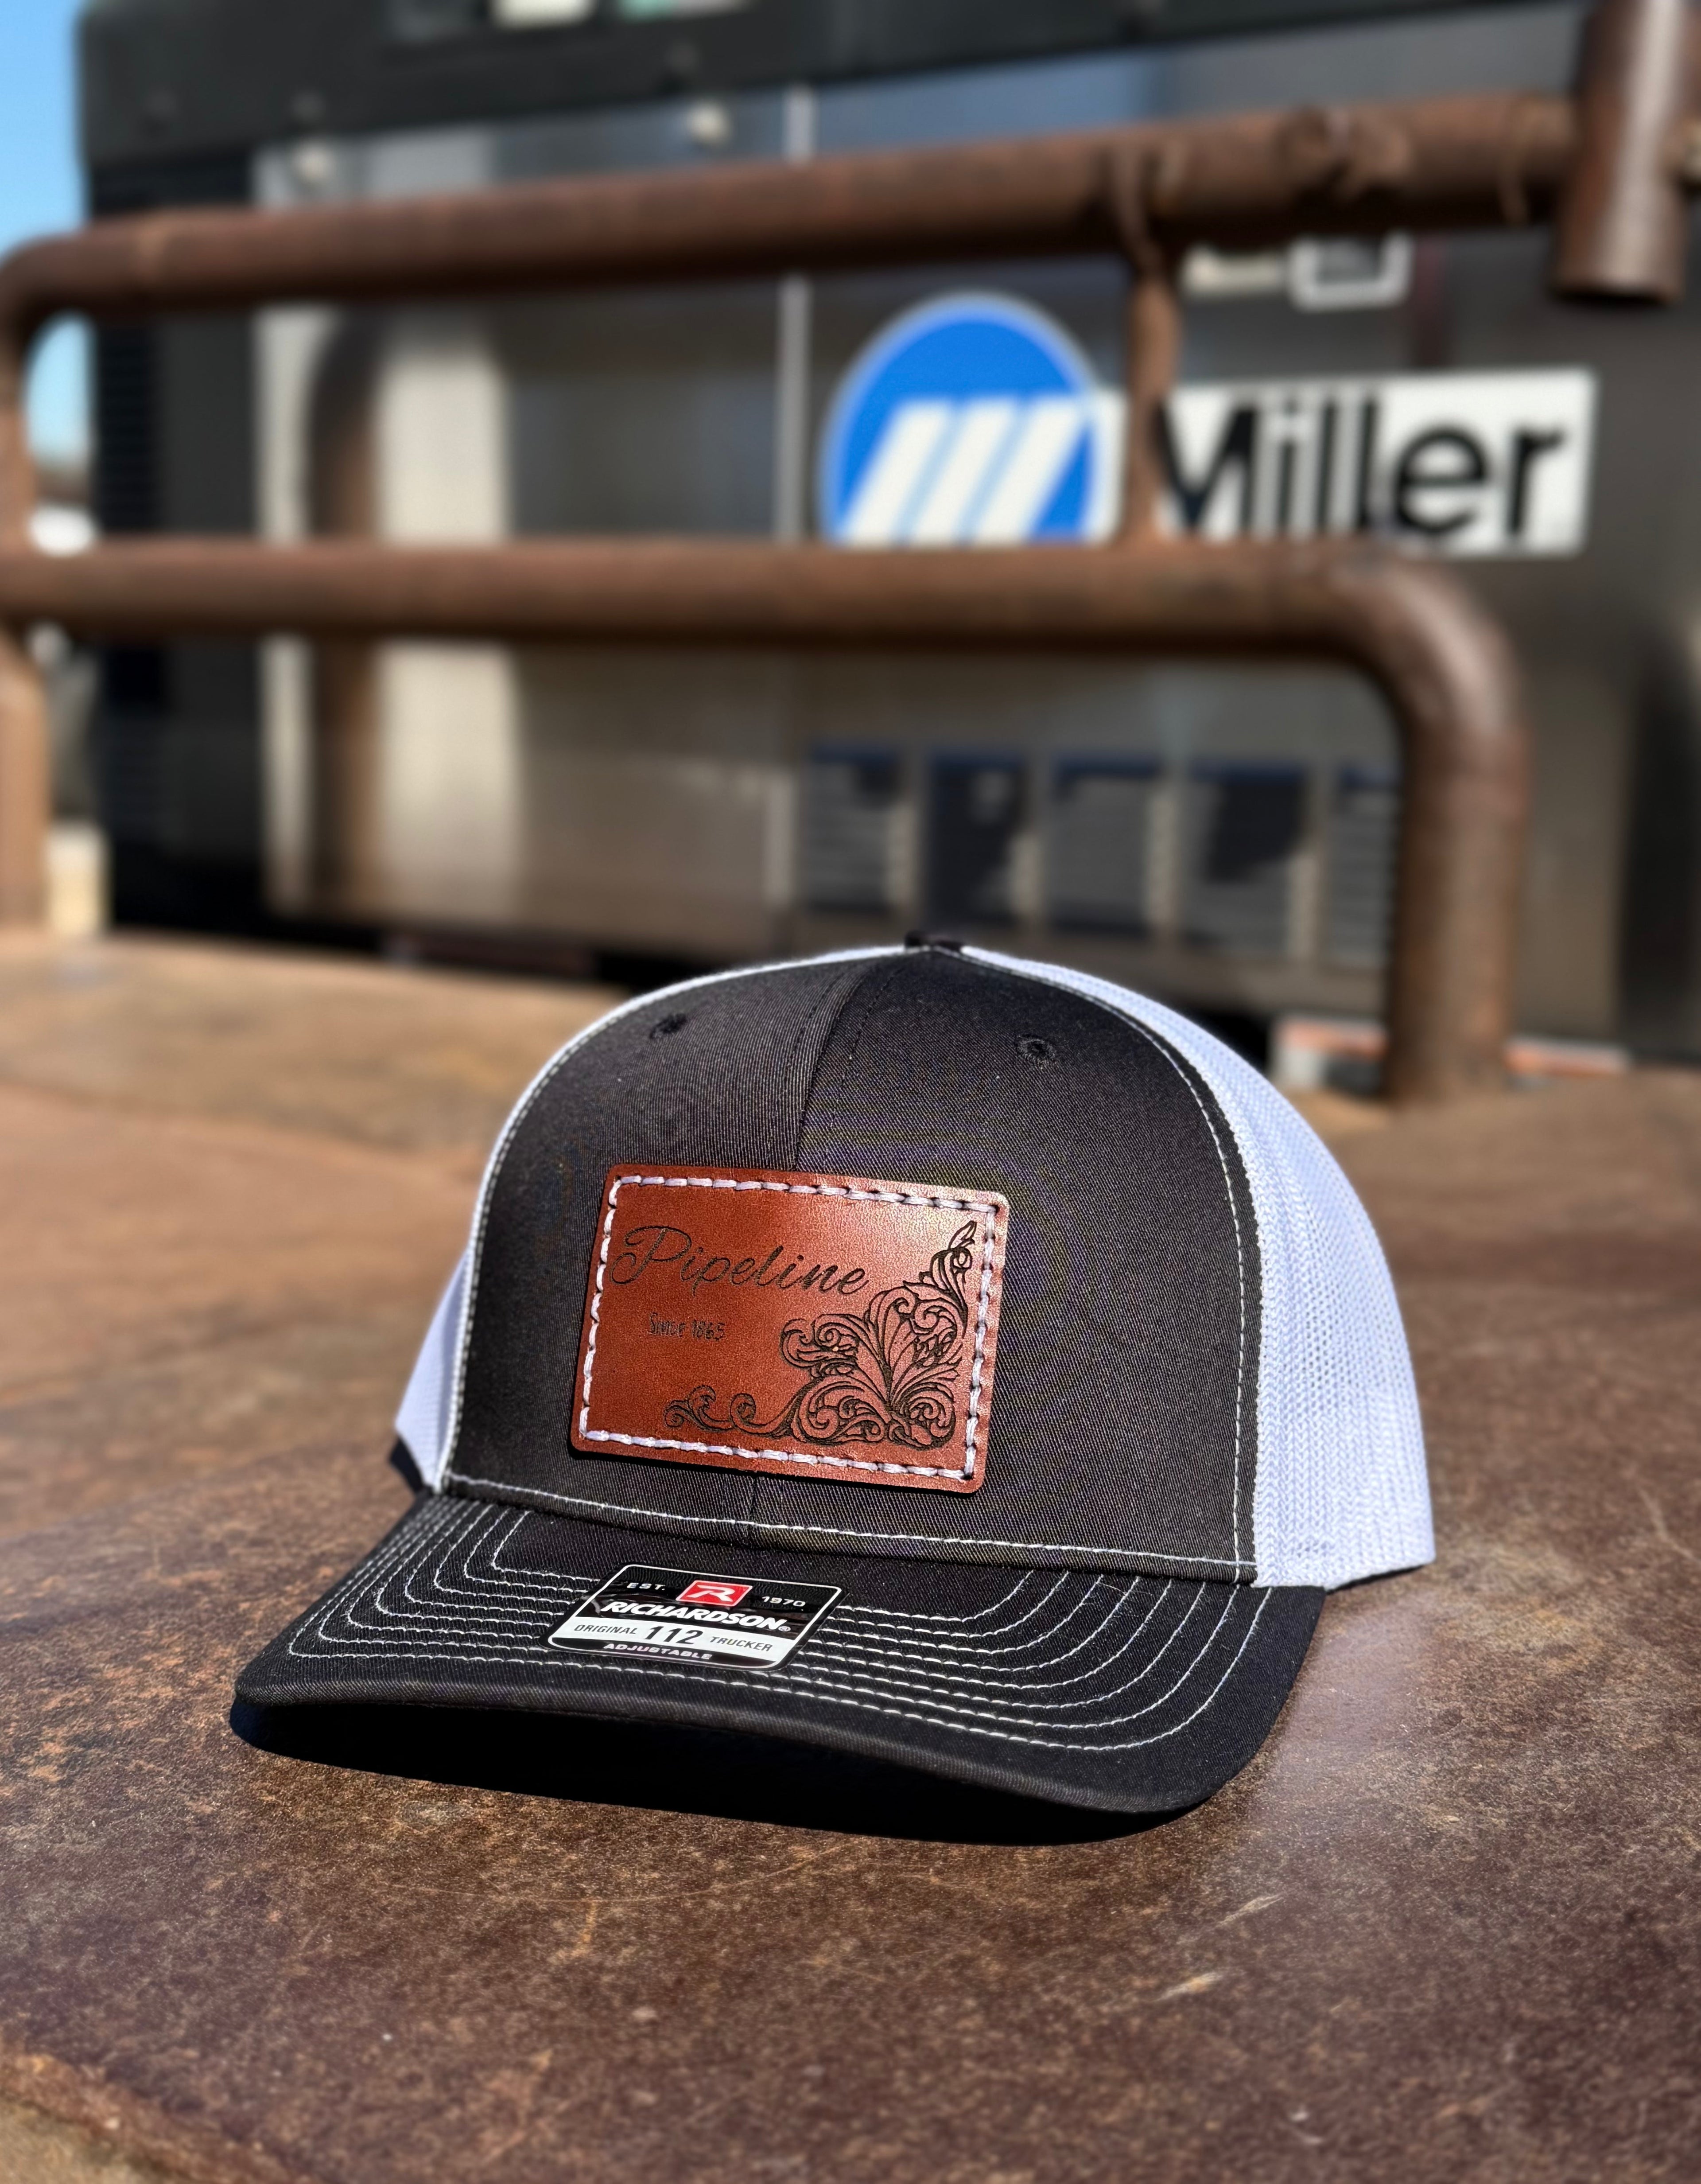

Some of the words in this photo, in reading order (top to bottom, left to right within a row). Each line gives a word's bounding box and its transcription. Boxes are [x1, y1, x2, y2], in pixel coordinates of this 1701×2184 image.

[1154, 394, 1565, 534] Miller
[610, 1225, 870, 1296] Pipeline
[647, 1312, 686, 1337] Since
[691, 1319, 726, 1341] 1865
[626, 1582, 665, 1591] EST.
[762, 1596, 806, 1607] 1970
[574, 1624, 638, 1635] ORIGINAL
[644, 1626, 703, 1645] 112
[709, 1636, 773, 1652] TRUCKER
[603, 1643, 713, 1660] ADJUSTABLE
